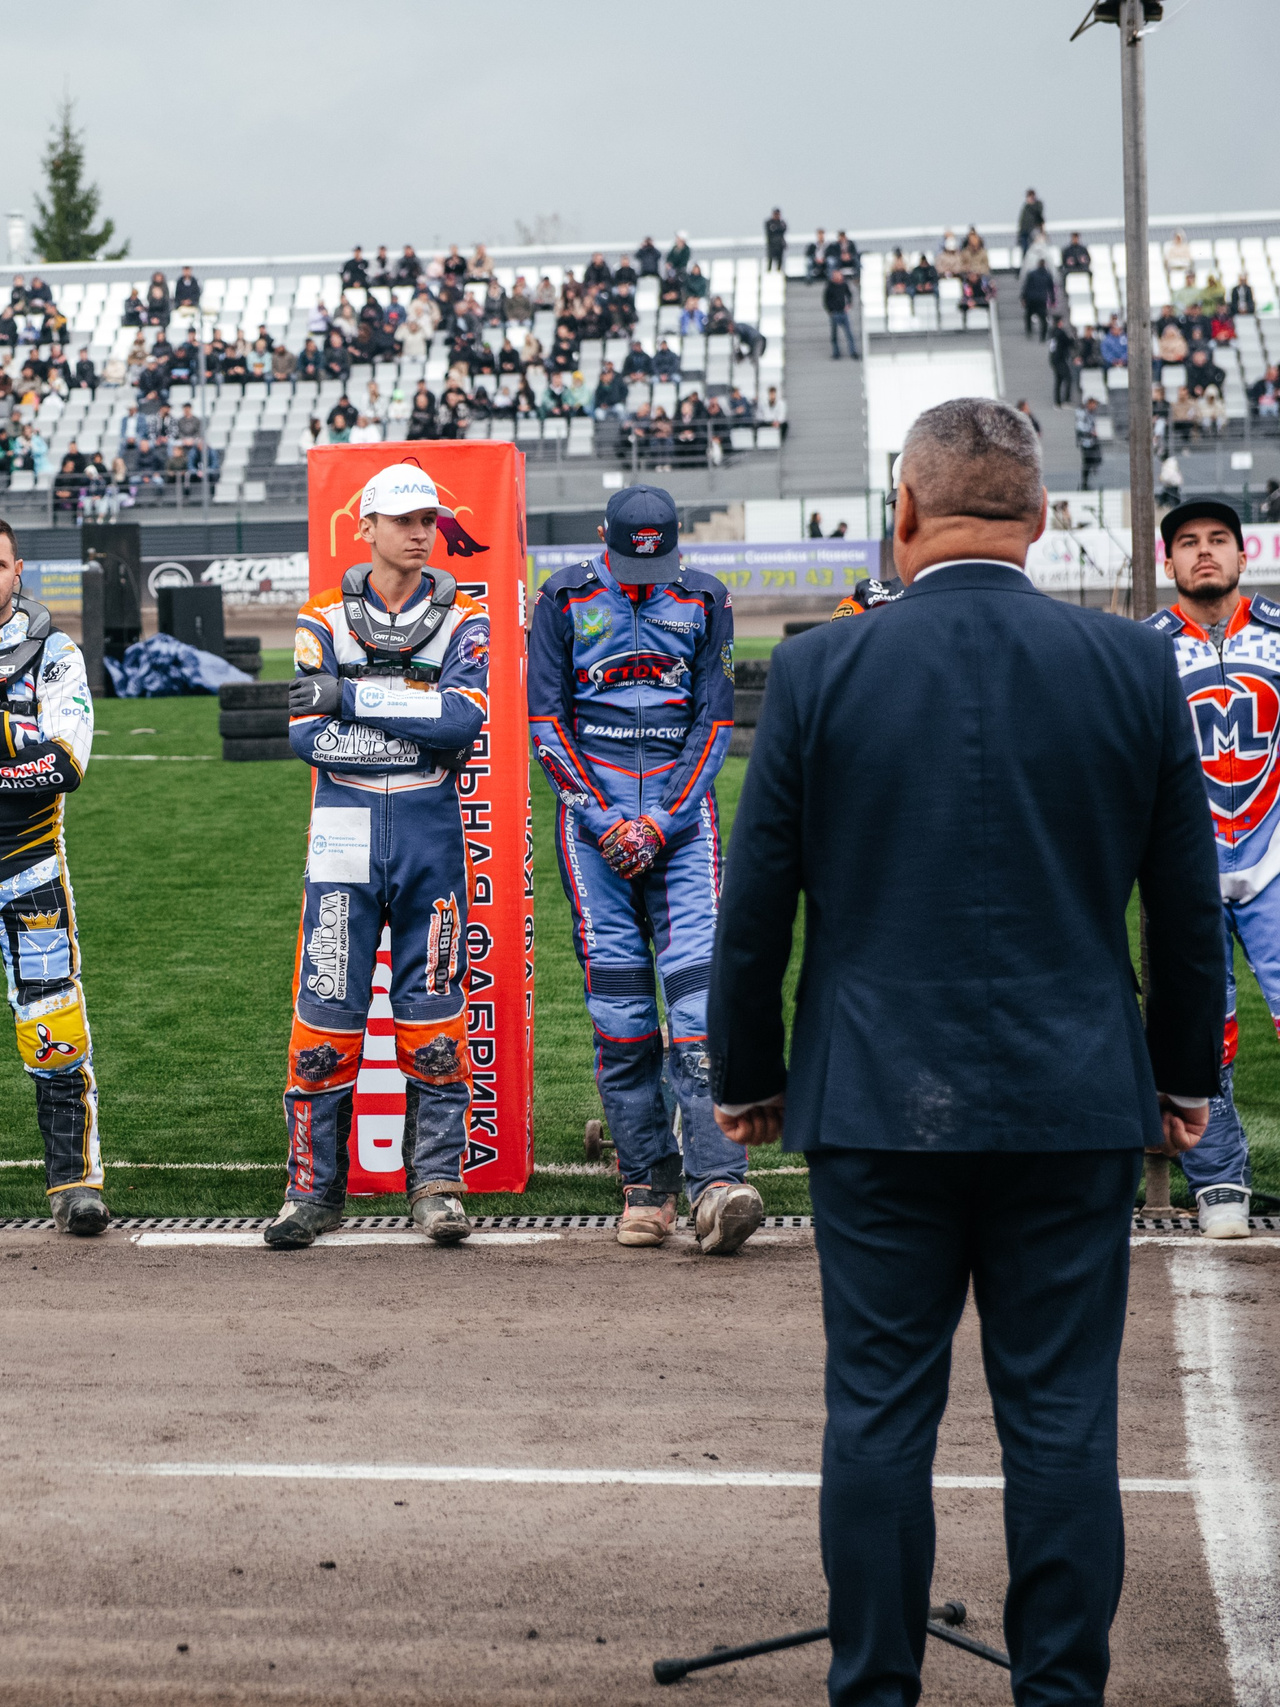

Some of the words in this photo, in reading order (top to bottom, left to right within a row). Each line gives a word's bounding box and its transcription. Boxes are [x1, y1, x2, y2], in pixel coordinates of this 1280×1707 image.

[374, 633, 405, 643] ORTEMA
[583, 724, 687, 738] ВЛАДИВОСТОК
[360, 755, 391, 763] RACING
[566, 808, 588, 898] ИМОРСКИЙ
[340, 895, 348, 918] TEAM
[339, 919, 348, 951] RACING
[465, 922, 499, 1175] ФАБРИКА
[295, 1103, 312, 1190] HAVAL
